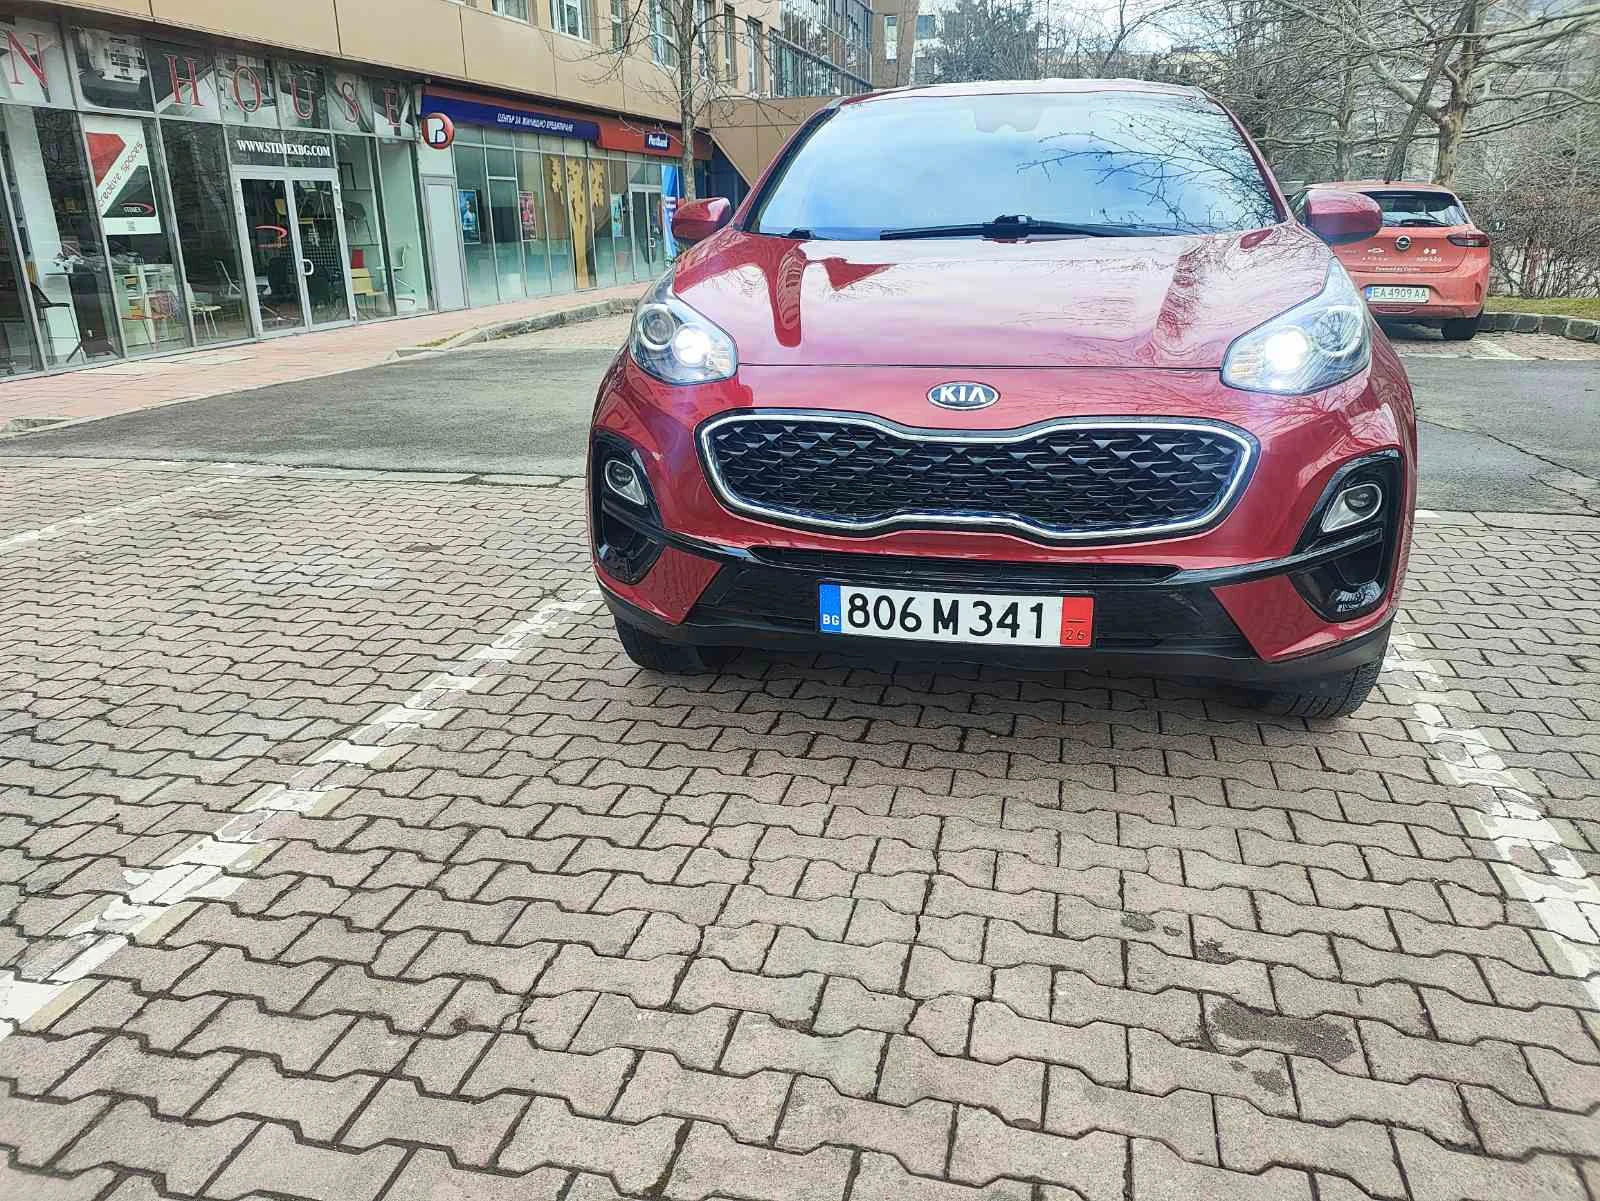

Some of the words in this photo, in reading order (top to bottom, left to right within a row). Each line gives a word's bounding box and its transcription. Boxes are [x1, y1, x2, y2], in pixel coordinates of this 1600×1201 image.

[163, 54, 401, 127] HOUSE
[237, 139, 331, 156] WWW.STIMEXBG.COM
[1373, 287, 1387, 298] EA
[1388, 287, 1412, 298] 4909
[1414, 288, 1427, 298] AA
[939, 386, 986, 403] KIA
[822, 613, 840, 627] BG
[847, 593, 922, 633] 806
[932, 598, 960, 635] M
[968, 600, 1044, 639] 341
[1064, 627, 1086, 641] 26
